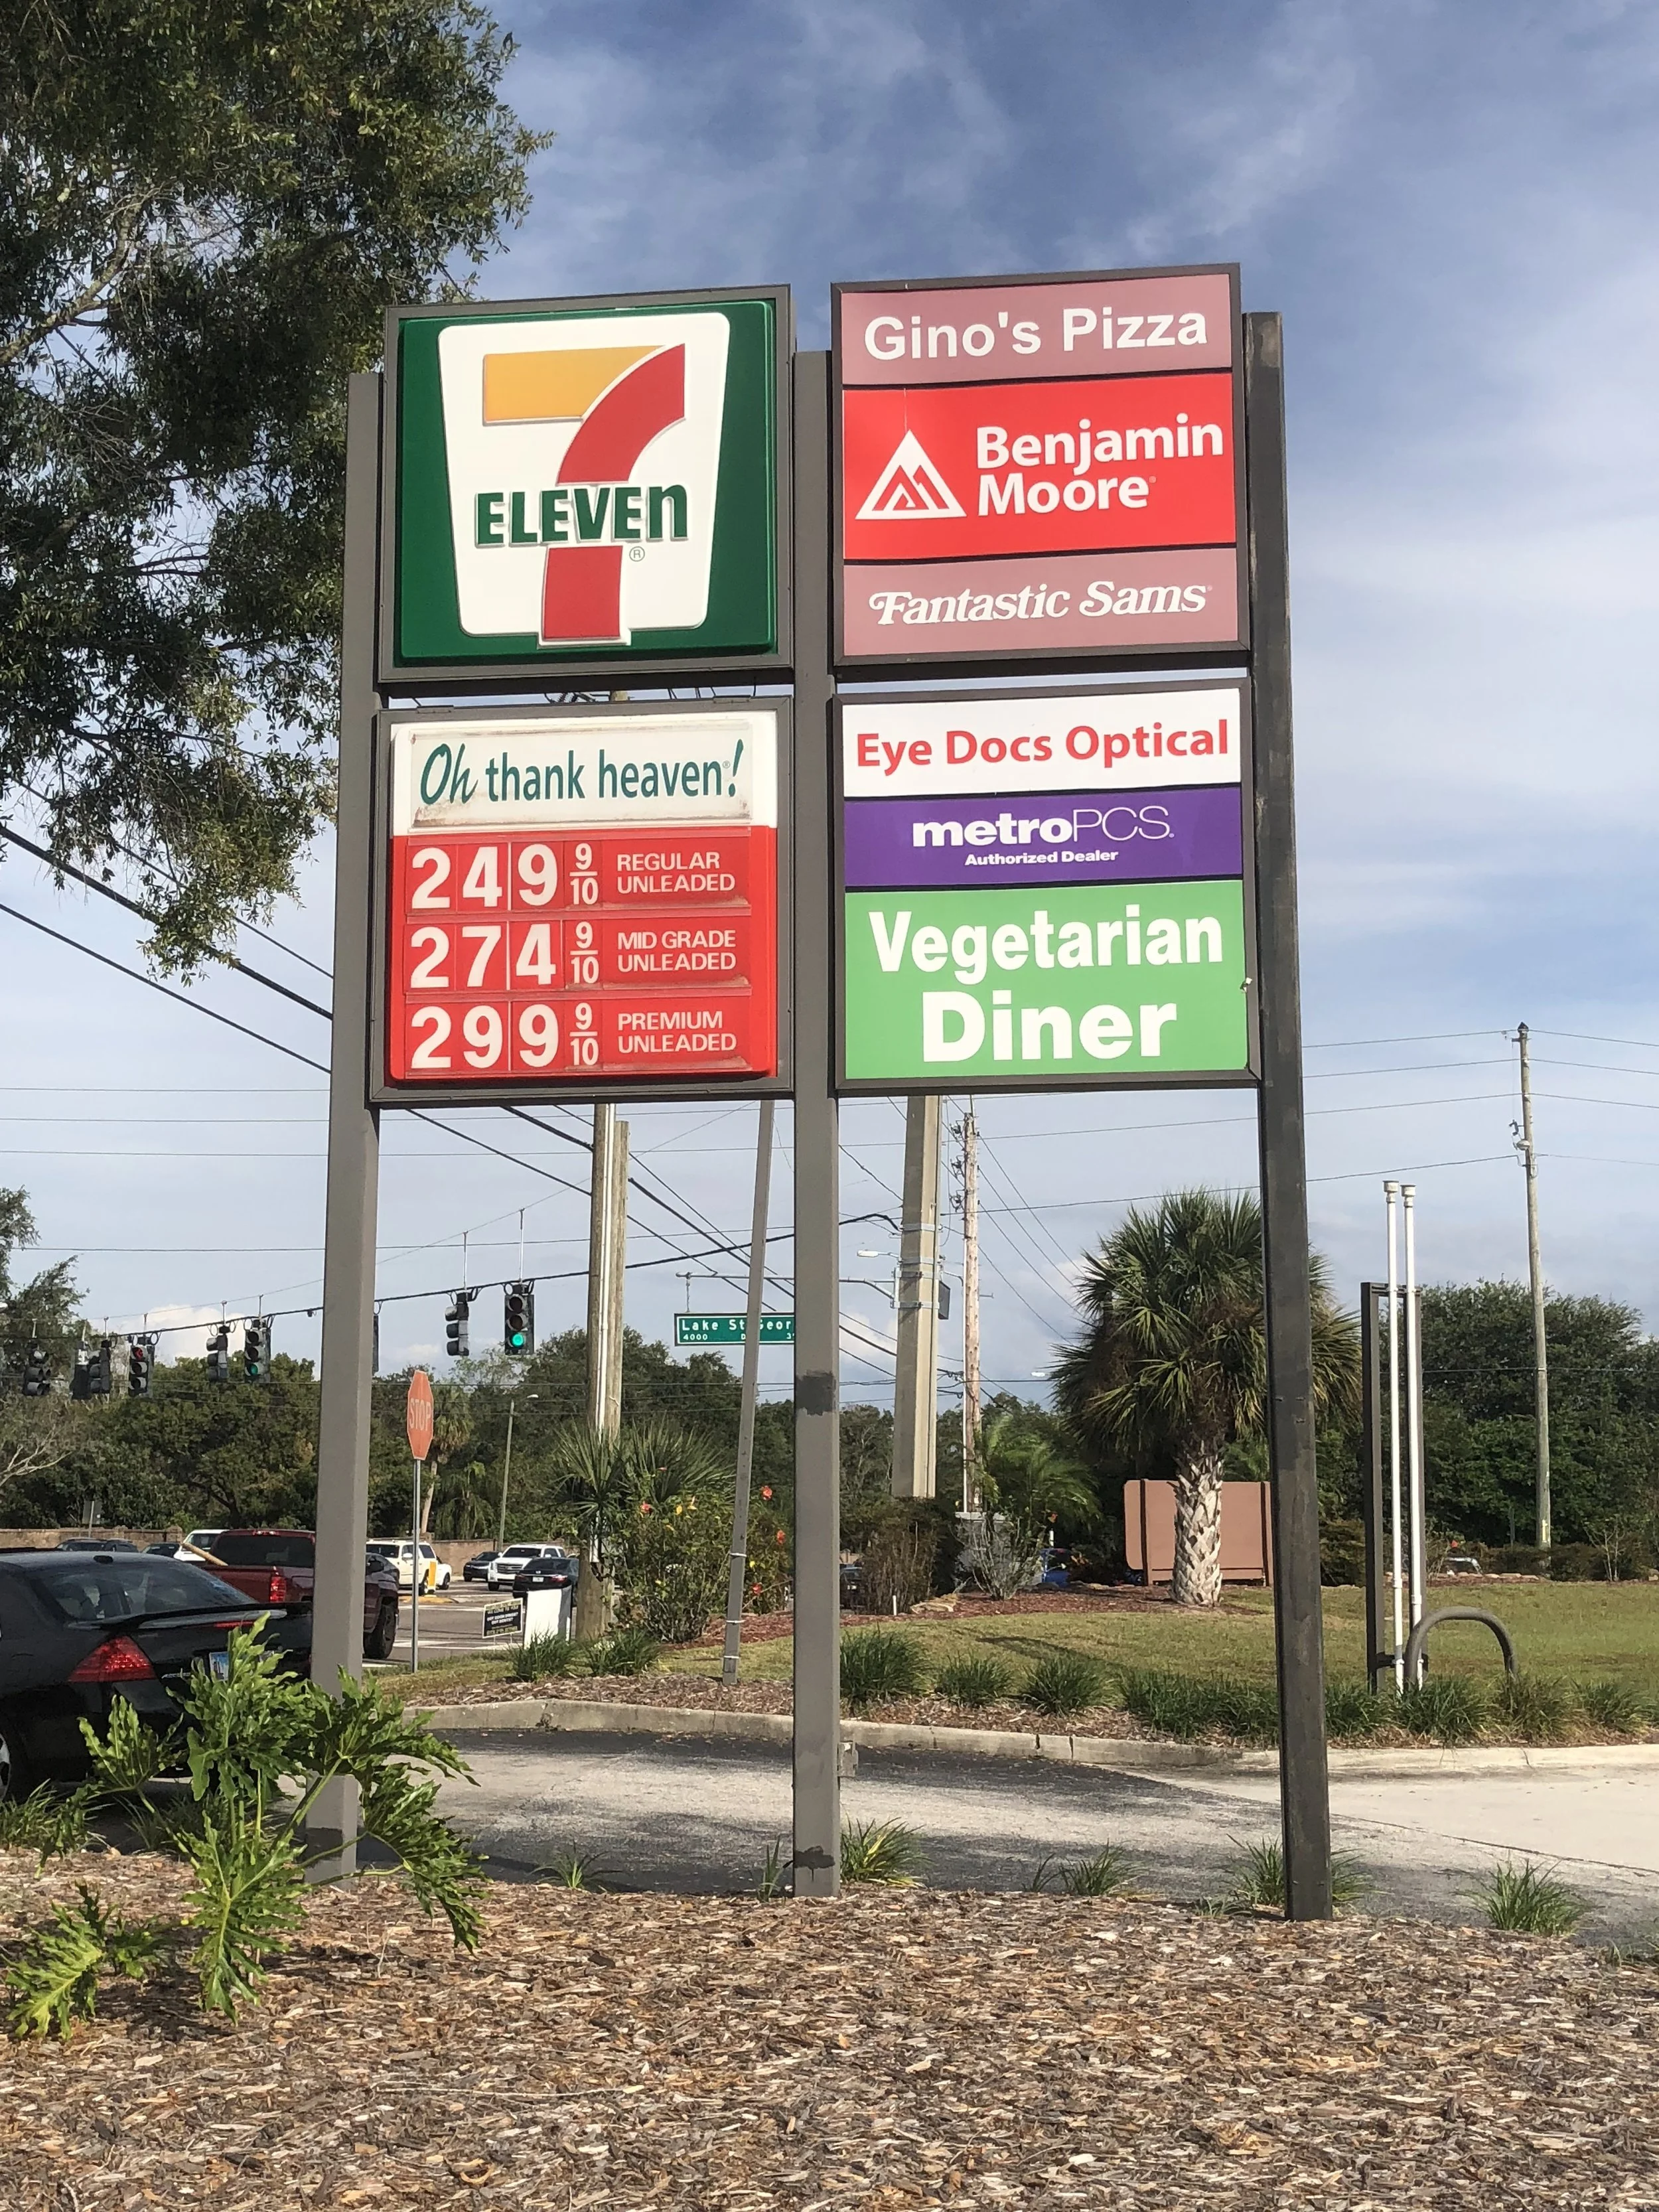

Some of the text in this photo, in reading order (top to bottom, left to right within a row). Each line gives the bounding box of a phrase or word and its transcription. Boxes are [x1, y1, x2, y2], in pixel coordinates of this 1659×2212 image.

[864, 306, 1208, 361] Gino's Pizza
[976, 412, 1224, 476] Benjamin
[482, 342, 686, 642] 7
[977, 473, 1150, 516] Moore
[474, 484, 689, 547] ELEVEn
[868, 580, 1207, 625] Fantastic Sams
[857, 719, 1228, 776] Eye Docs Optical
[419, 743, 479, 805] Oh
[484, 749, 585, 801] thank
[616, 851, 721, 871] REGULAR
[964, 849, 1119, 866] Authorized Dealer
[616, 873, 736, 894] UNLEADED
[617, 930, 737, 950] MID GRADE
[868, 904, 1223, 986] Vegetarian
[617, 952, 737, 972] UNLEADED
[617, 1011, 724, 1030] PREMIUM
[922, 990, 1177, 1063] Diner
[617, 1033, 738, 1053] UNLEADED
[682, 1319, 719, 1331] Lake
[729, 1319, 745, 1331] St
[409, 1398, 432, 1432] STOP
